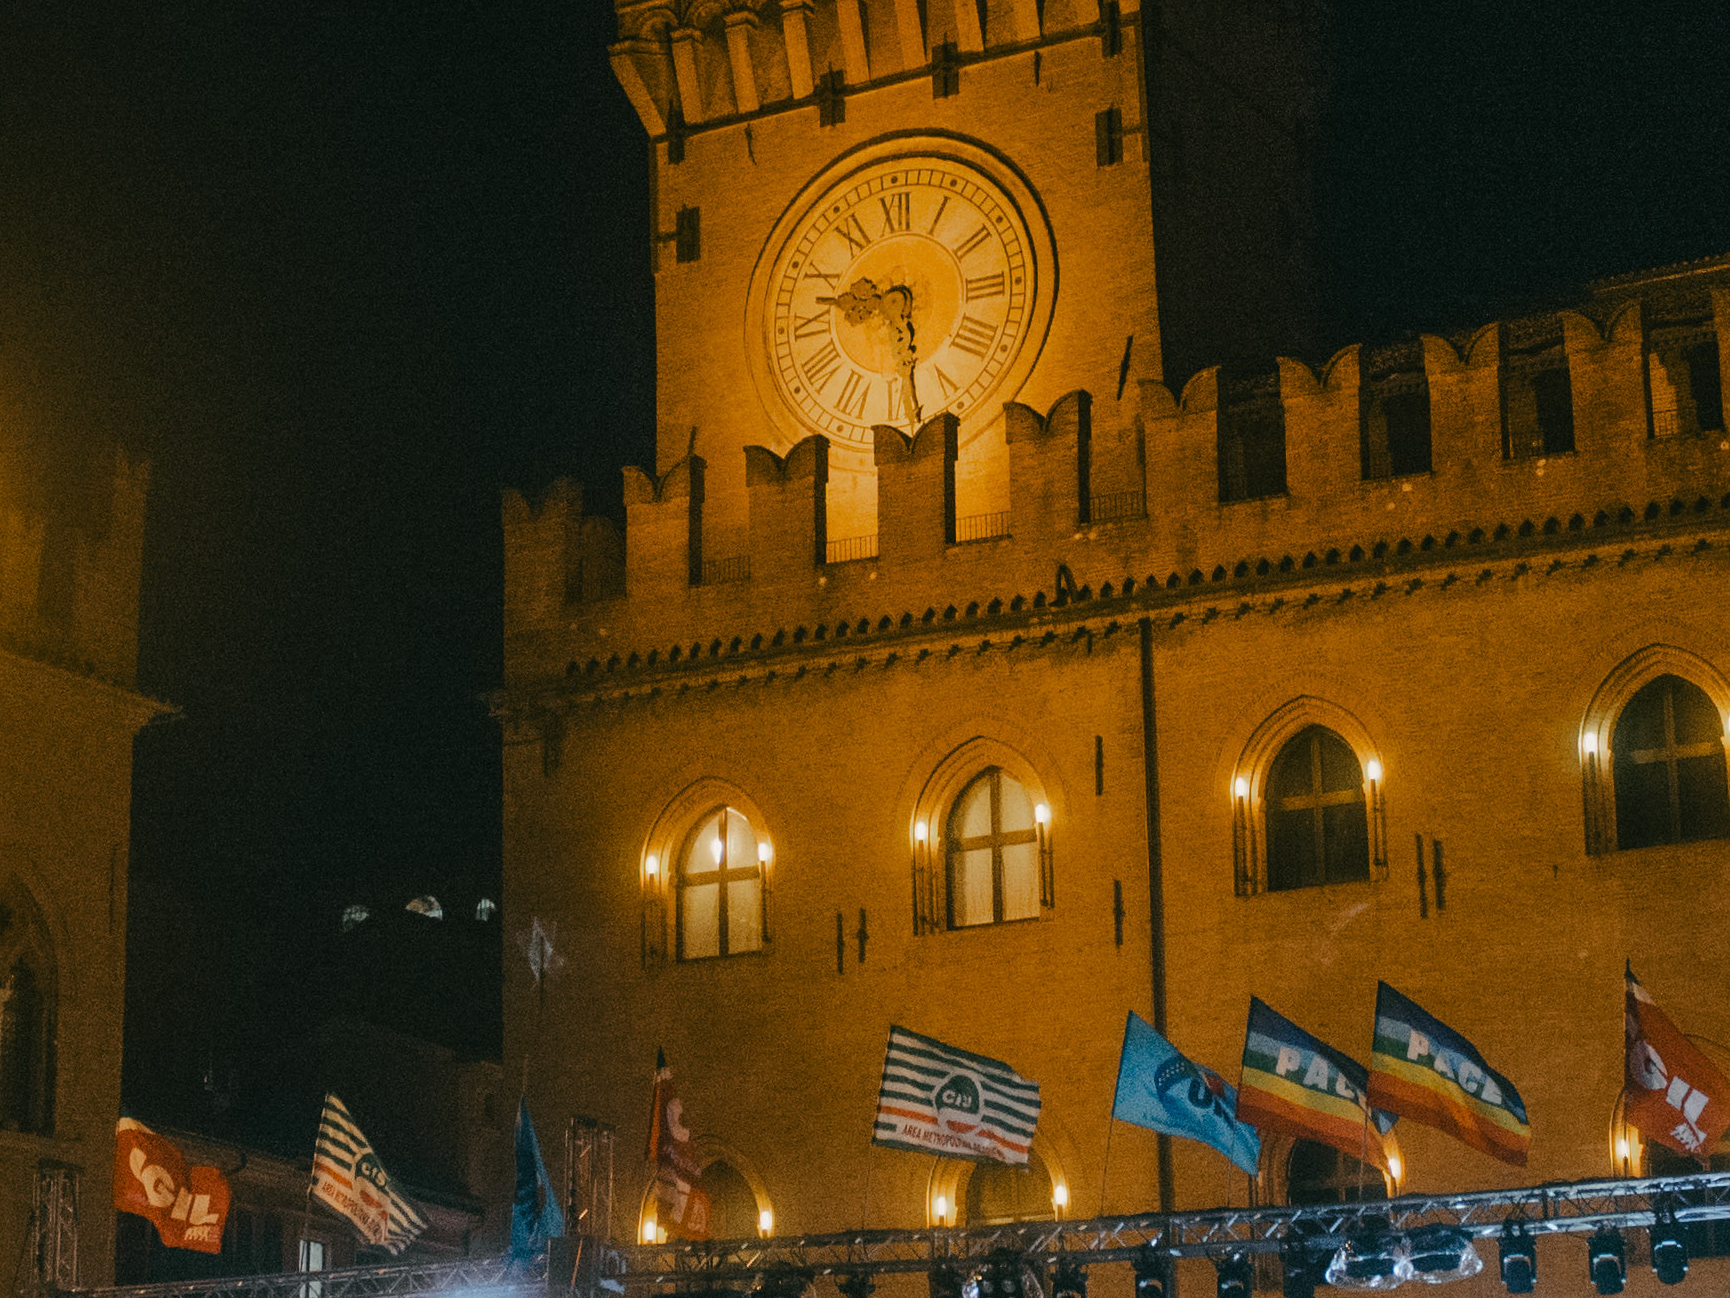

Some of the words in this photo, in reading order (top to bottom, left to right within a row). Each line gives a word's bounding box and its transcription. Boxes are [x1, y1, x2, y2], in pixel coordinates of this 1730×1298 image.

[880, 192, 911, 233] XII
[929, 196, 949, 235] I
[835, 212, 871, 258] XI
[954, 223, 990, 259] II
[804, 262, 840, 290] X
[966, 271, 1004, 302] III
[795, 313, 830, 341] IX
[951, 316, 996, 358] IIII
[802, 338, 840, 394] VIII
[935, 364, 960, 400] V
[835, 369, 872, 418] VII
[1628, 1036, 1710, 1144] GIL
[361, 1161, 388, 1187] CIS
